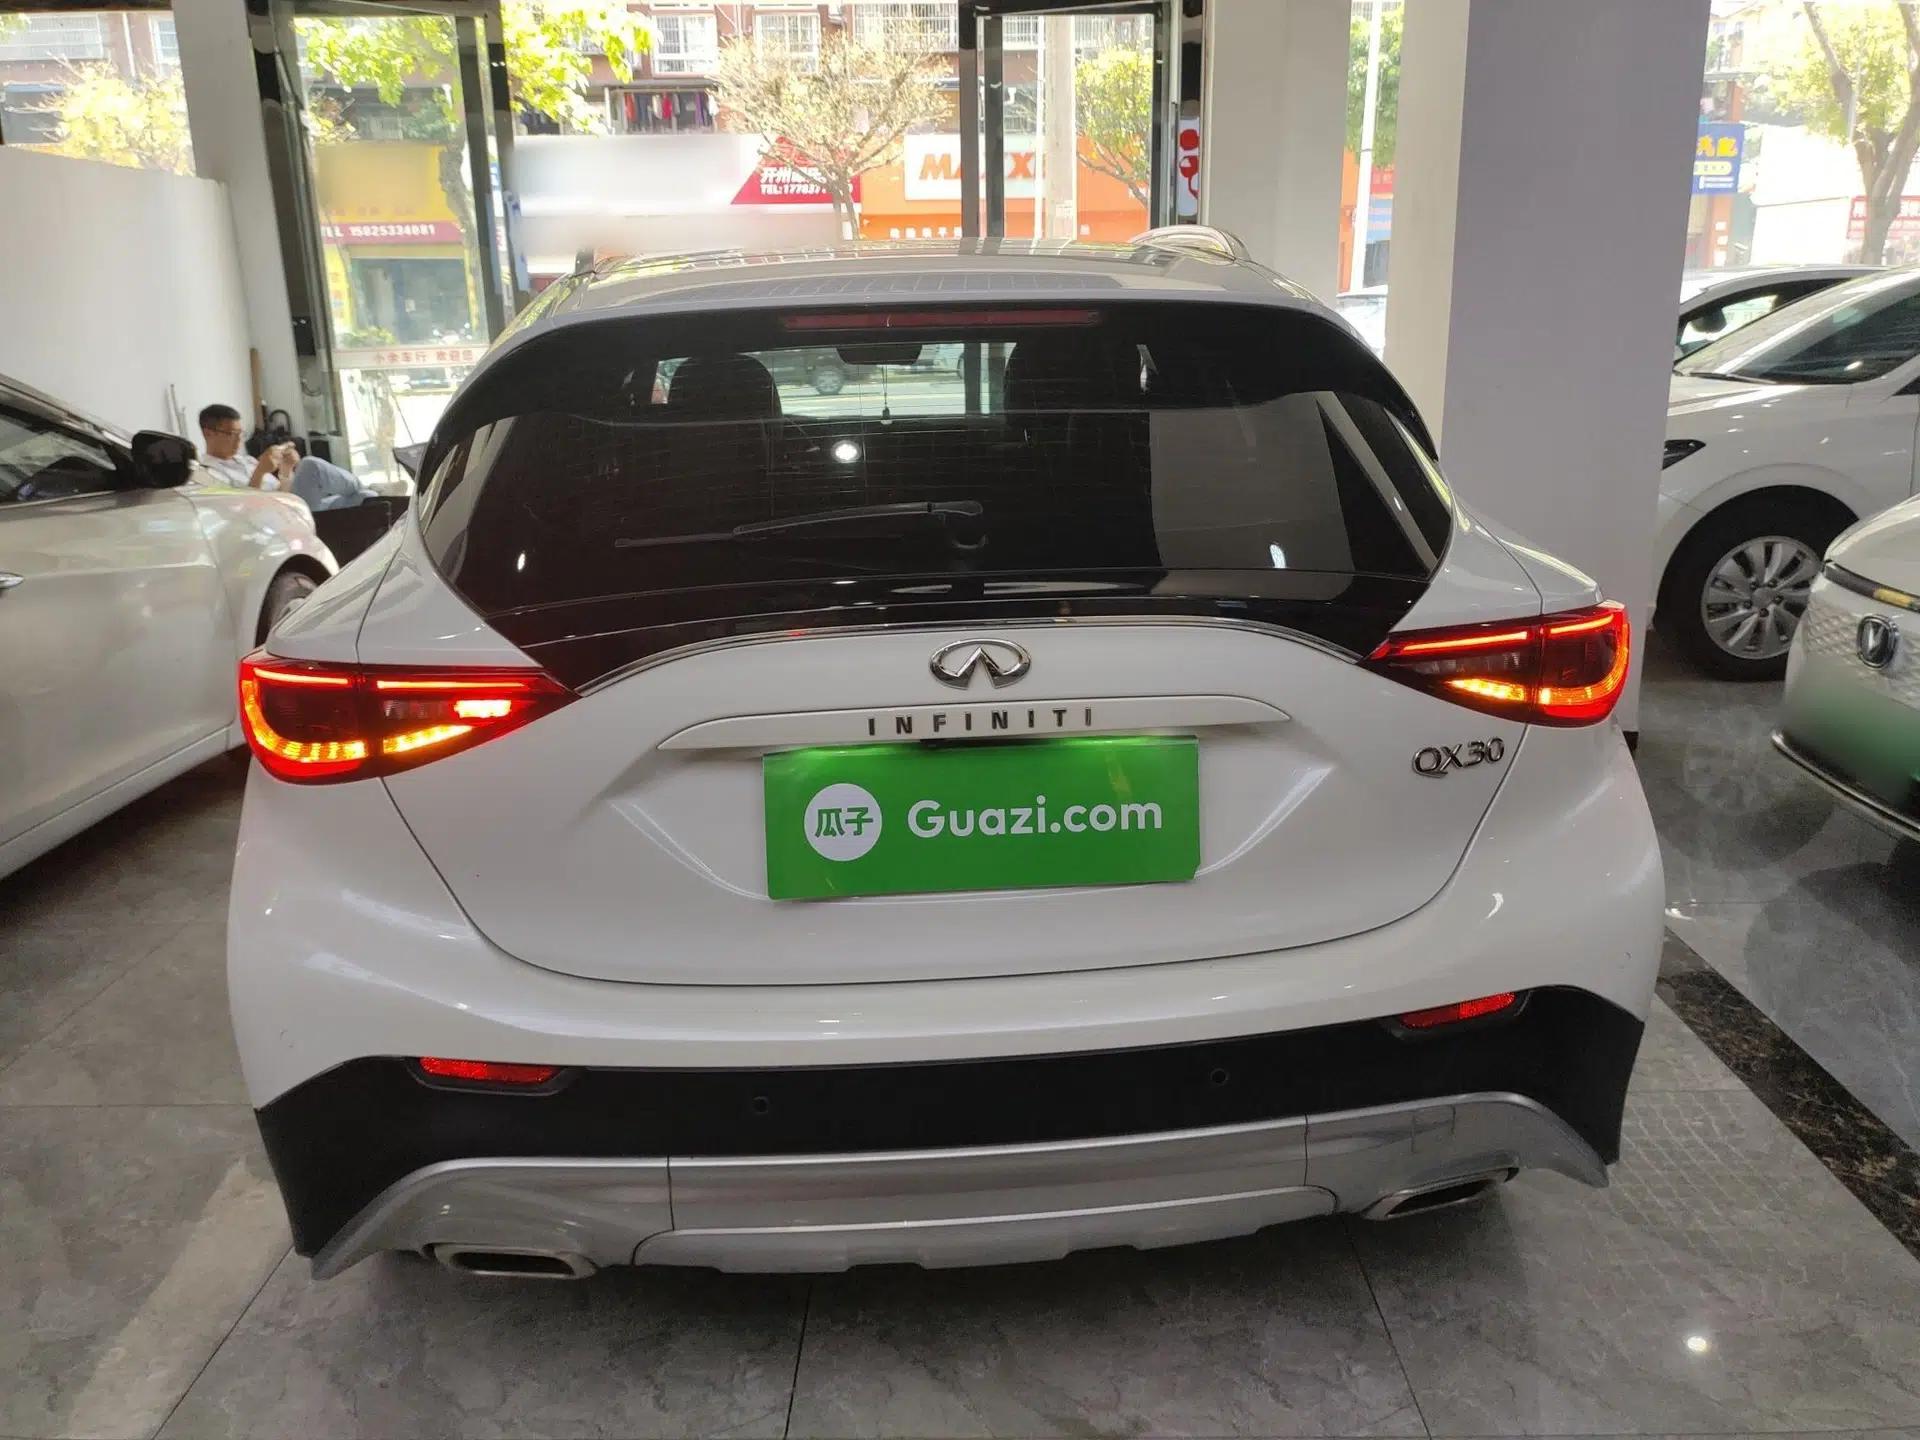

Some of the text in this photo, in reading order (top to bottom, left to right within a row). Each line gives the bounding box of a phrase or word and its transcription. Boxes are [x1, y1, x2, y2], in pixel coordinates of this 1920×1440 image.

[868, 707, 1093, 736] INFINITI
[1412, 737, 1505, 779] QX30
[815, 795, 1163, 839] 瓜子 Guazi.com
